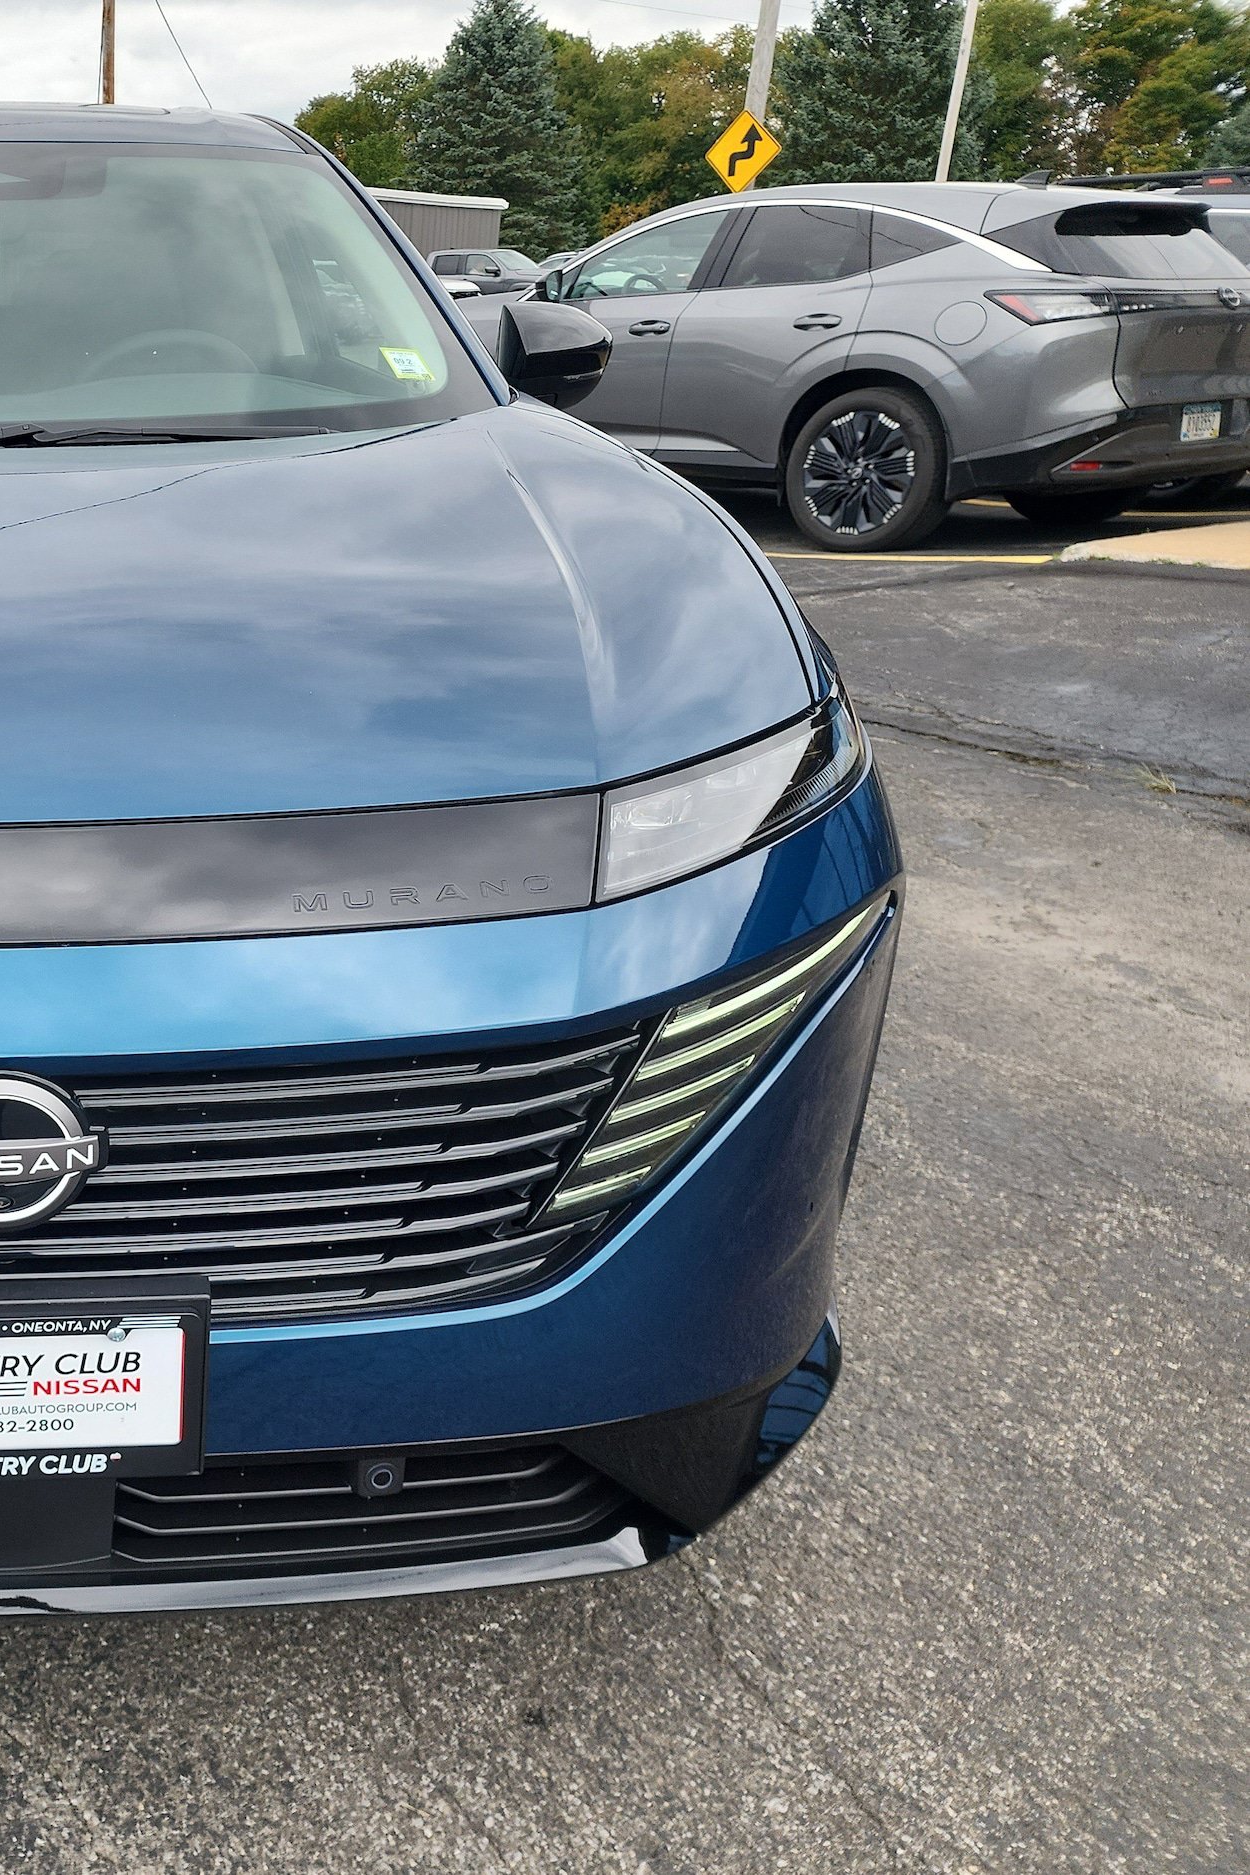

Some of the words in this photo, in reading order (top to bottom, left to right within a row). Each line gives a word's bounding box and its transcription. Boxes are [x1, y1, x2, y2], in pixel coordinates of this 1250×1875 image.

[292, 875, 554, 913] MURANO
[54, 1351, 141, 1375] CLUB
[33, 1378, 141, 1396] NISSAN
[39, 1453, 108, 1475] CLUB
